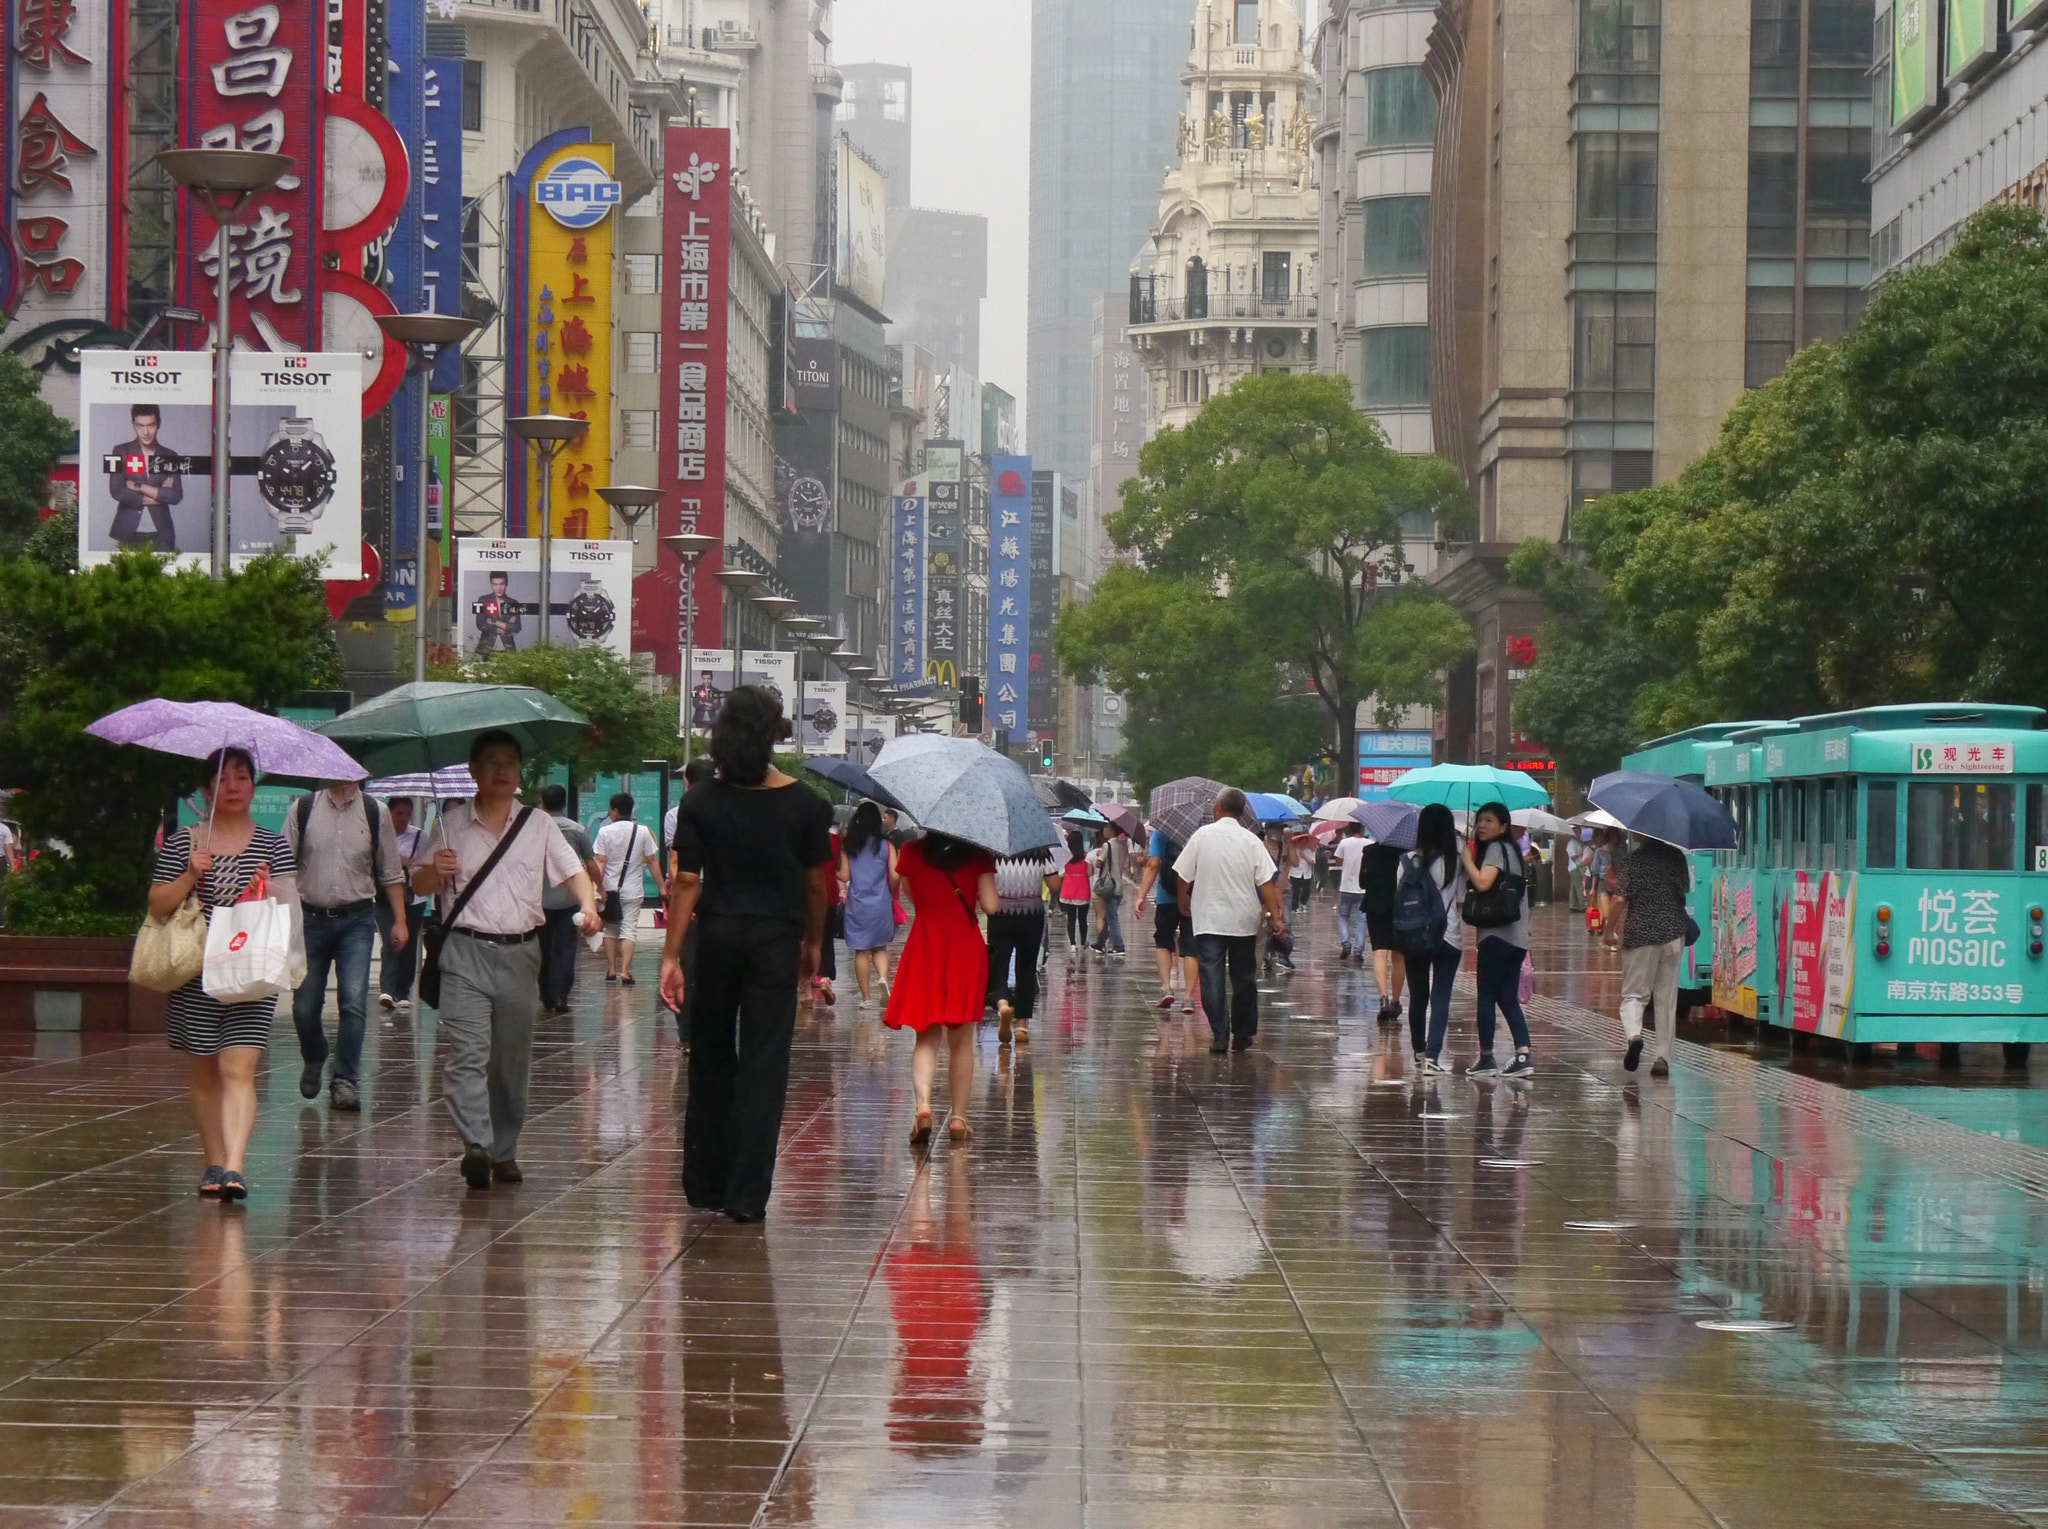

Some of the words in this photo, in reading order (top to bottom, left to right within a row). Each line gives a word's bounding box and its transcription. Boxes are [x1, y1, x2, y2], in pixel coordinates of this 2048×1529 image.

[537, 183, 619, 202] BAC
[678, 211, 710, 481] 上海市第一食品商店
[111, 371, 182, 384] TISSOT
[260, 372, 332, 386] TISSOT
[797, 370, 829, 383] TITONI
[680, 498, 701, 539] Firs
[477, 550, 521, 560] TISSOT
[569, 551, 614, 561] TISSOT
[901, 515, 919, 674] 上海市第一医药商店
[933, 588, 955, 650] 真丝大王
[997, 509, 1021, 730] 江蘇陽光集團公司
[900, 675, 937, 692] PHARMACY
[1944, 747, 2005, 761] 观光车
[1938, 763, 1954, 771] City
[1960, 763, 2005, 772] Sightseeing
[1918, 887, 2001, 935] 悦荟
[1887, 980, 2025, 1004] 南京东路353号
